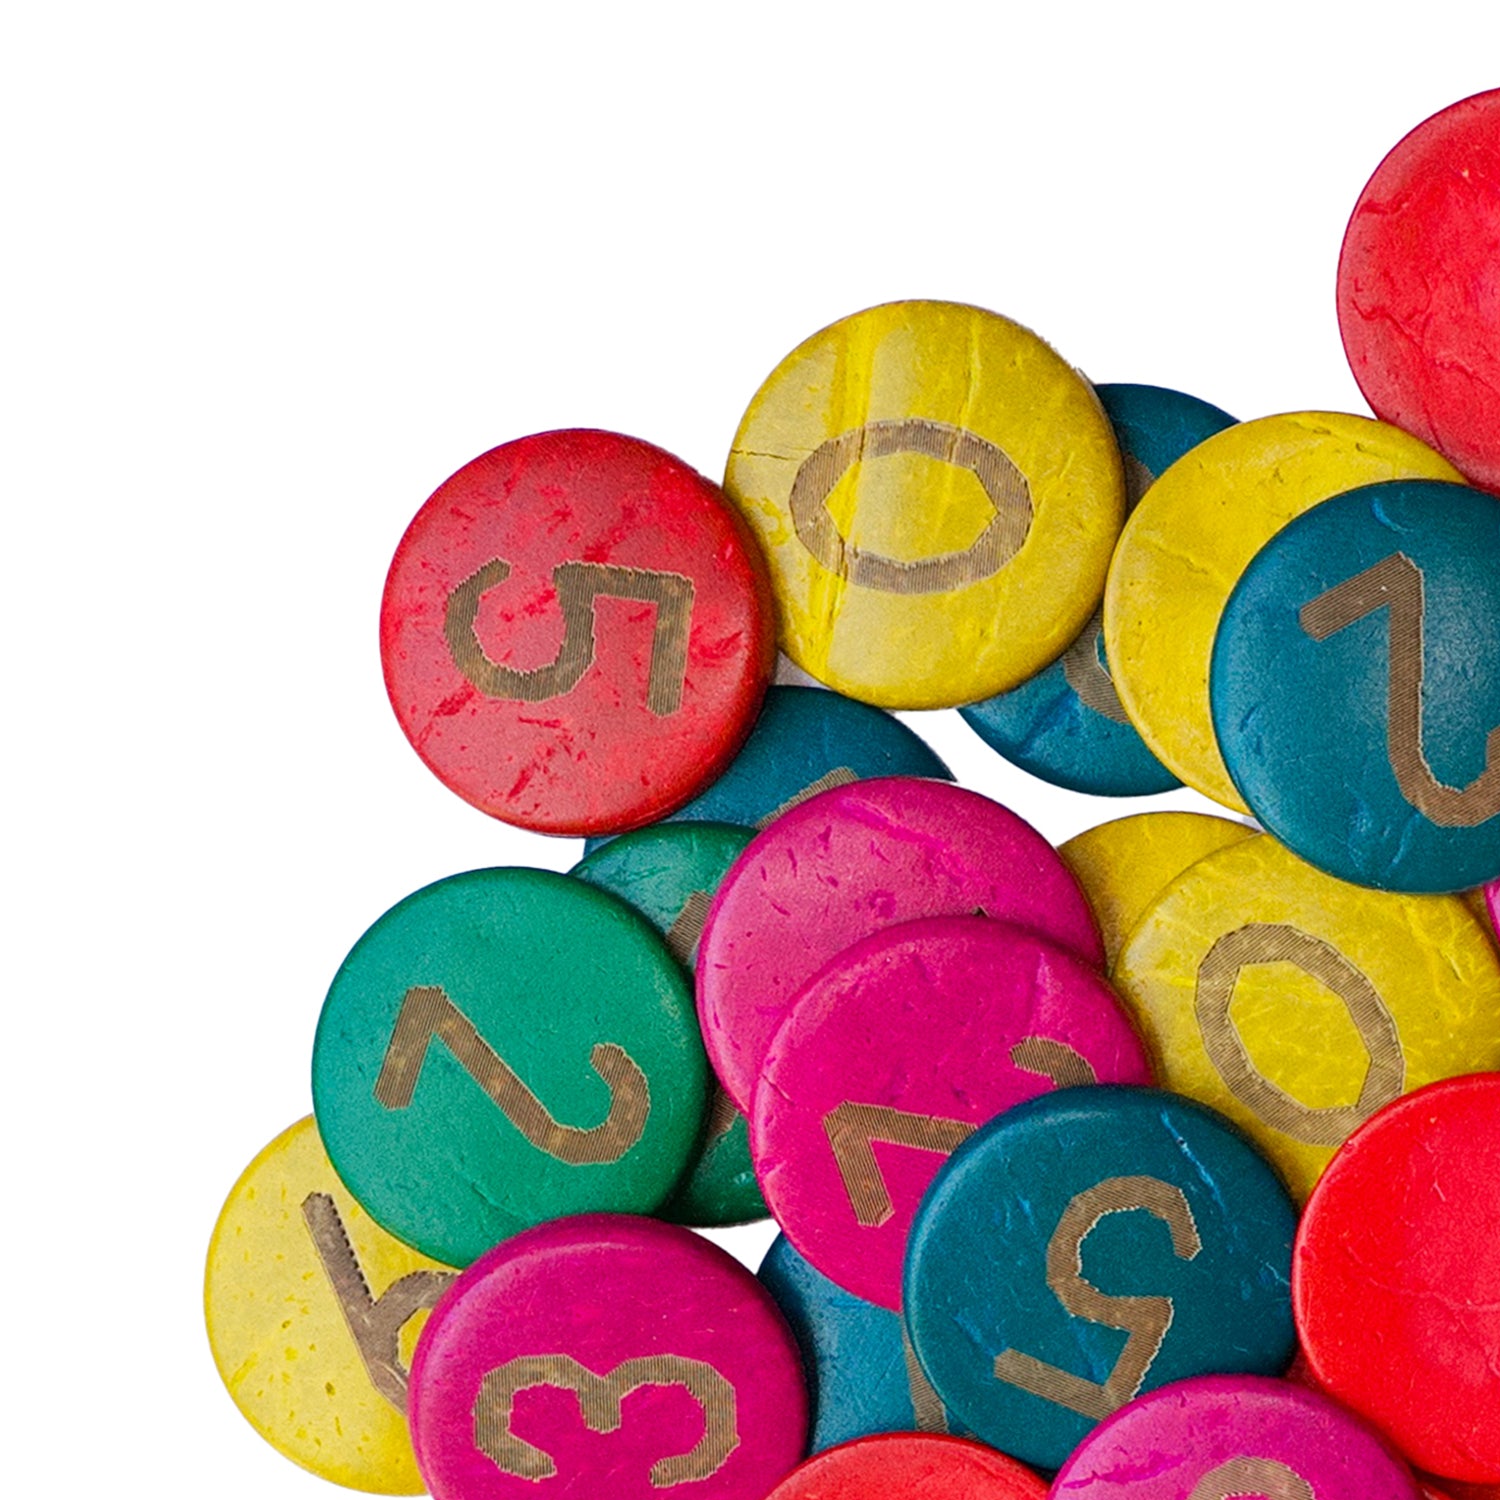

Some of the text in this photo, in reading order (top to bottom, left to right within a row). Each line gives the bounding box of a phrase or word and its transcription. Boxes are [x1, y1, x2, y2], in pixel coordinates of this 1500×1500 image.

[789, 417, 1034, 595] 0
[443, 556, 696, 718] 5
[371, 985, 651, 1167] 2
[1193, 922, 1406, 1147] 0
[992, 1174, 1202, 1421] 5
[471, 1353, 741, 1489] 3
